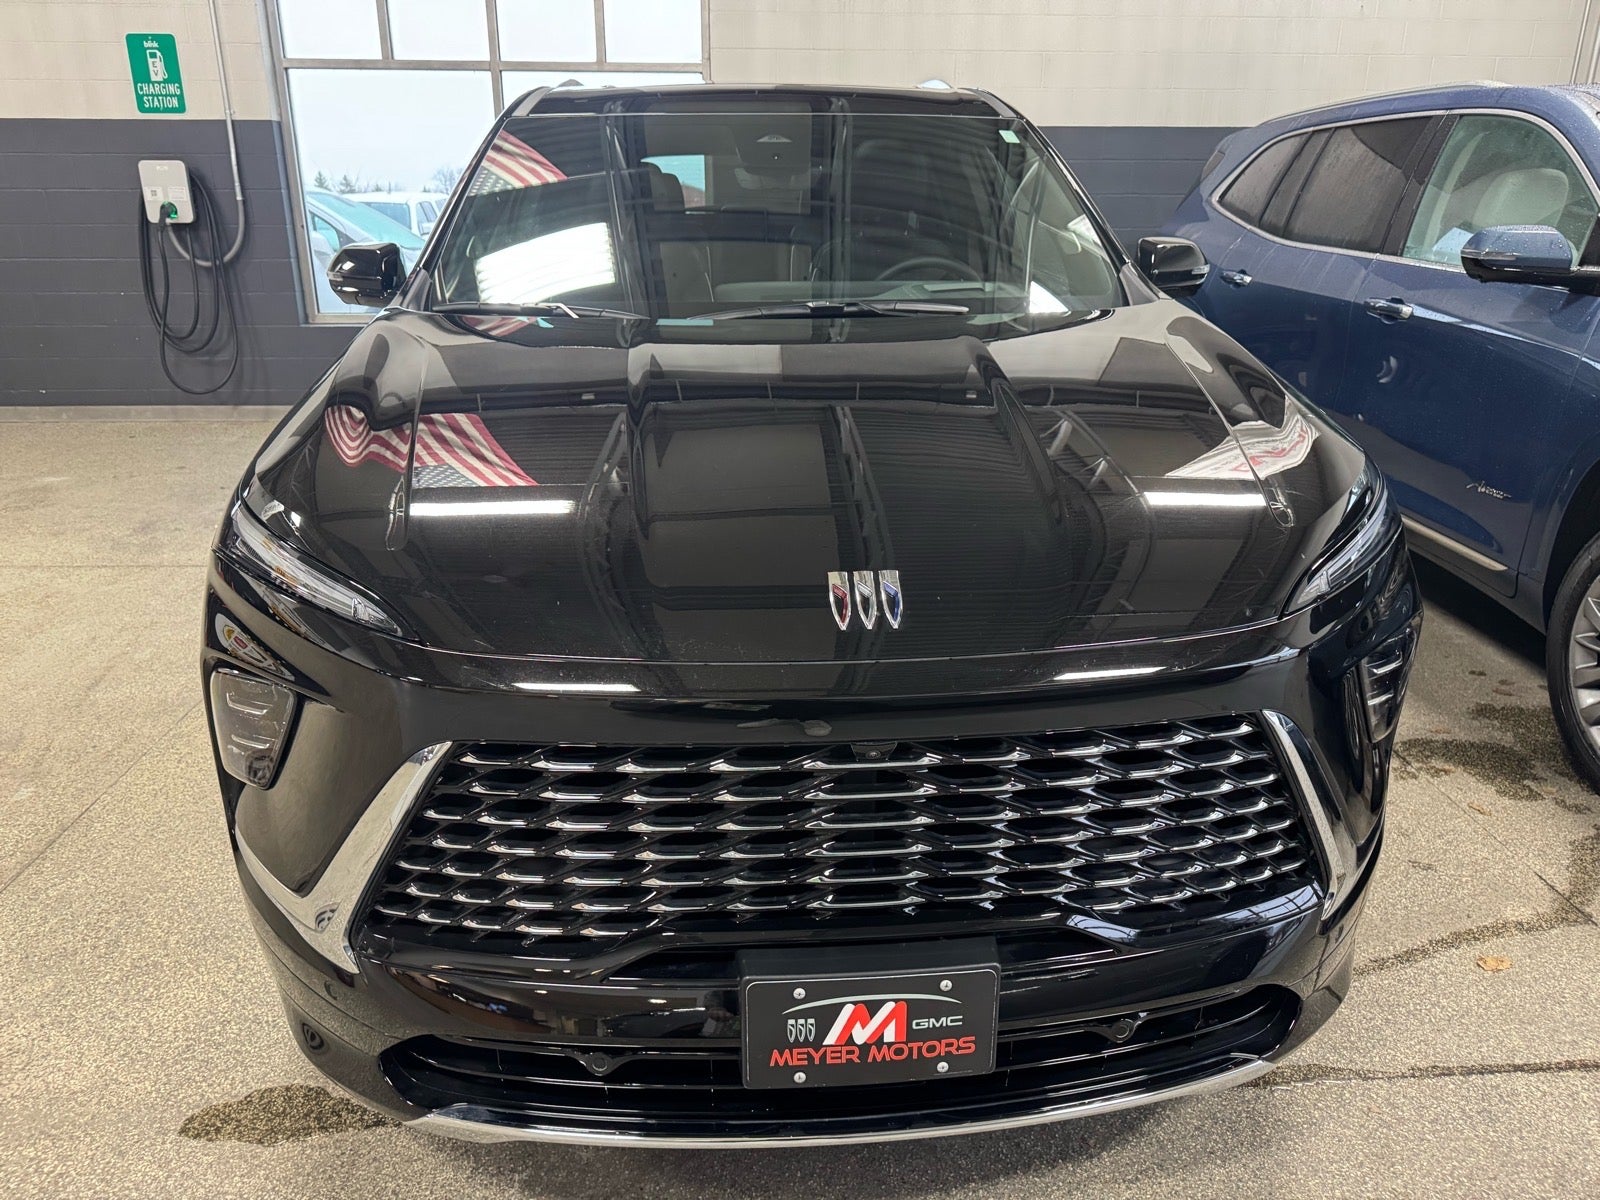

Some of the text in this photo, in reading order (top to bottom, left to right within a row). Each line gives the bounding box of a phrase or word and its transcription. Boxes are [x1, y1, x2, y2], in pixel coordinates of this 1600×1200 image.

[143, 36, 159, 48] blink
[137, 83, 180, 95] CHARGING
[143, 97, 179, 108] STATION
[912, 1016, 963, 1030] GMC
[769, 1036, 976, 1067] MEYER MOTORS
